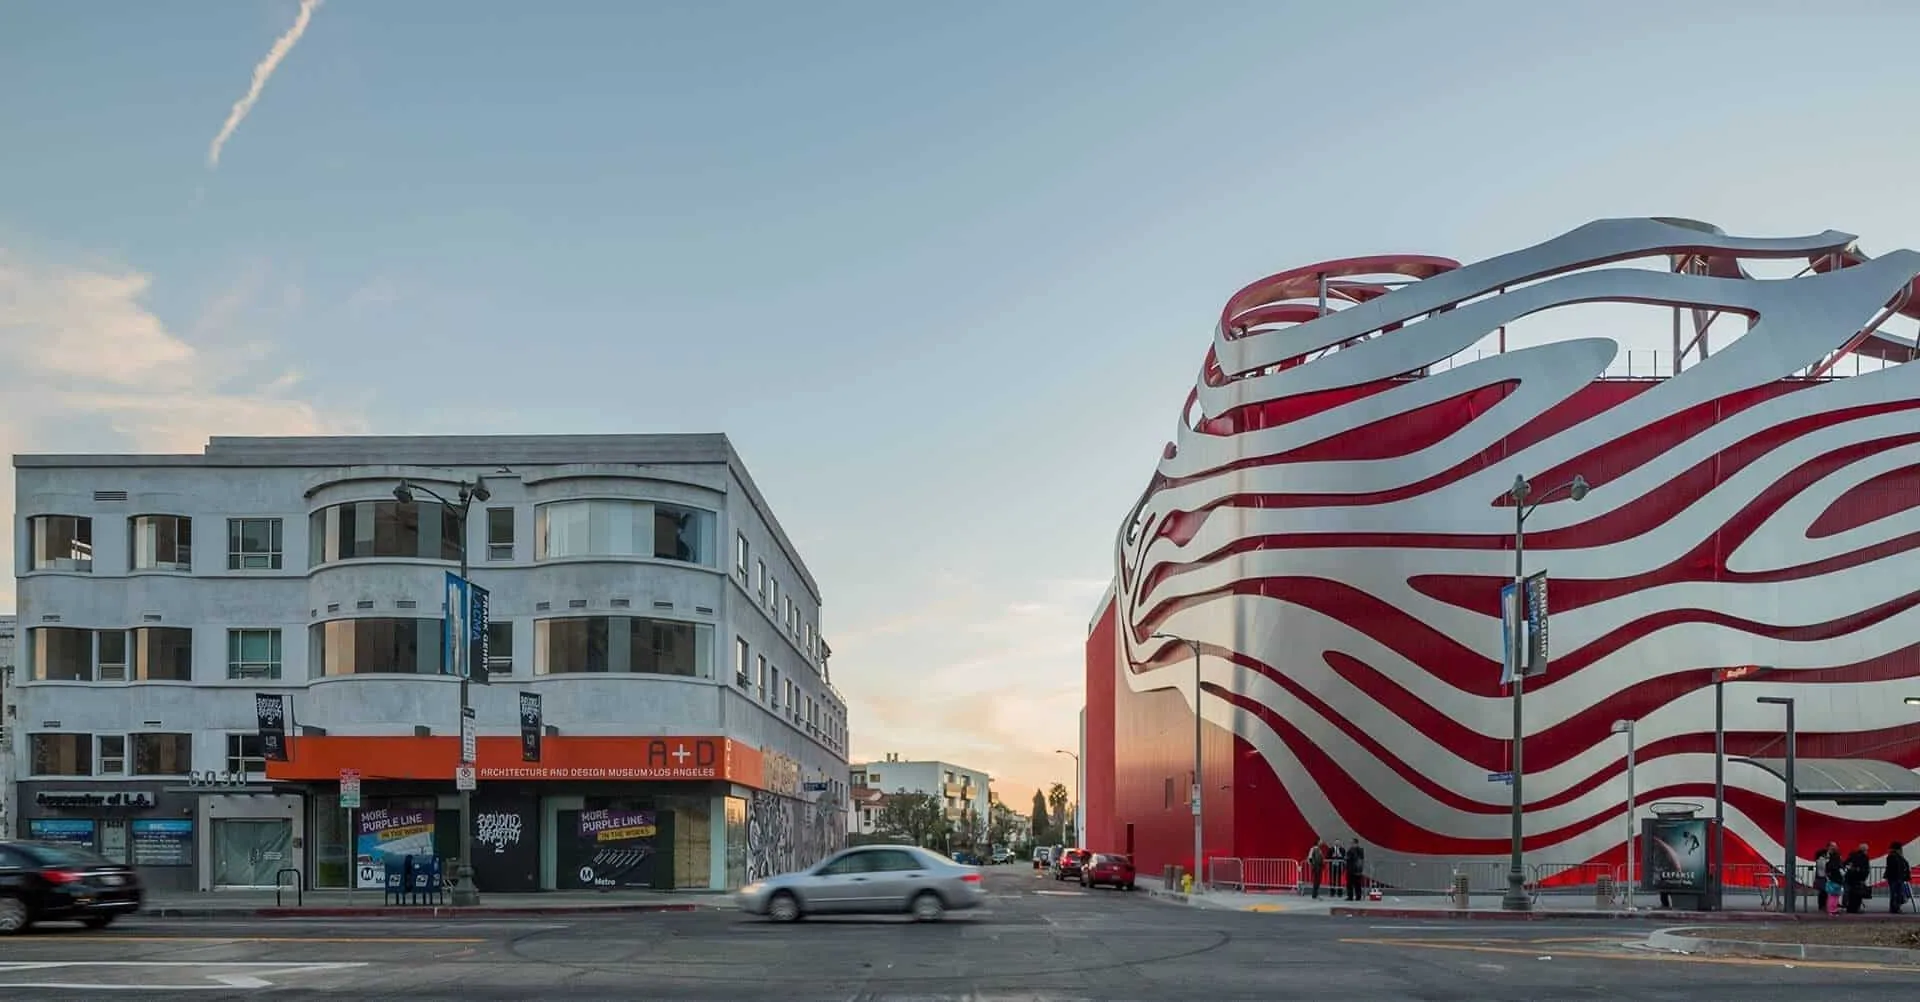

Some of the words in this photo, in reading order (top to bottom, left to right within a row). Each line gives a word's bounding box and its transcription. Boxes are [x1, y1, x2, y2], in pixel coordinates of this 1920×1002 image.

[1529, 580, 1540, 632] LACMA
[1538, 577, 1547, 617] FRANK
[472, 590, 481, 641] LACMA
[481, 594, 489, 632] FRANK
[1540, 619, 1548, 657] GEHRY
[481, 634, 489, 672] GEHRY
[189, 769, 248, 786] 6030
[480, 768, 548, 777] ARCHITECTURE
[550, 768, 568, 777] AND
[571, 768, 606, 777] DESIGN
[673, 768, 715, 777] ANGELES
[361, 809, 388, 822] MORE
[362, 815, 399, 832] PURPLE
[400, 813, 423, 826] LINE
[581, 809, 609, 823] MORE
[582, 817, 620, 833] PURPLE
[622, 815, 644, 826] LINE
[594, 877, 616, 886] Metro
